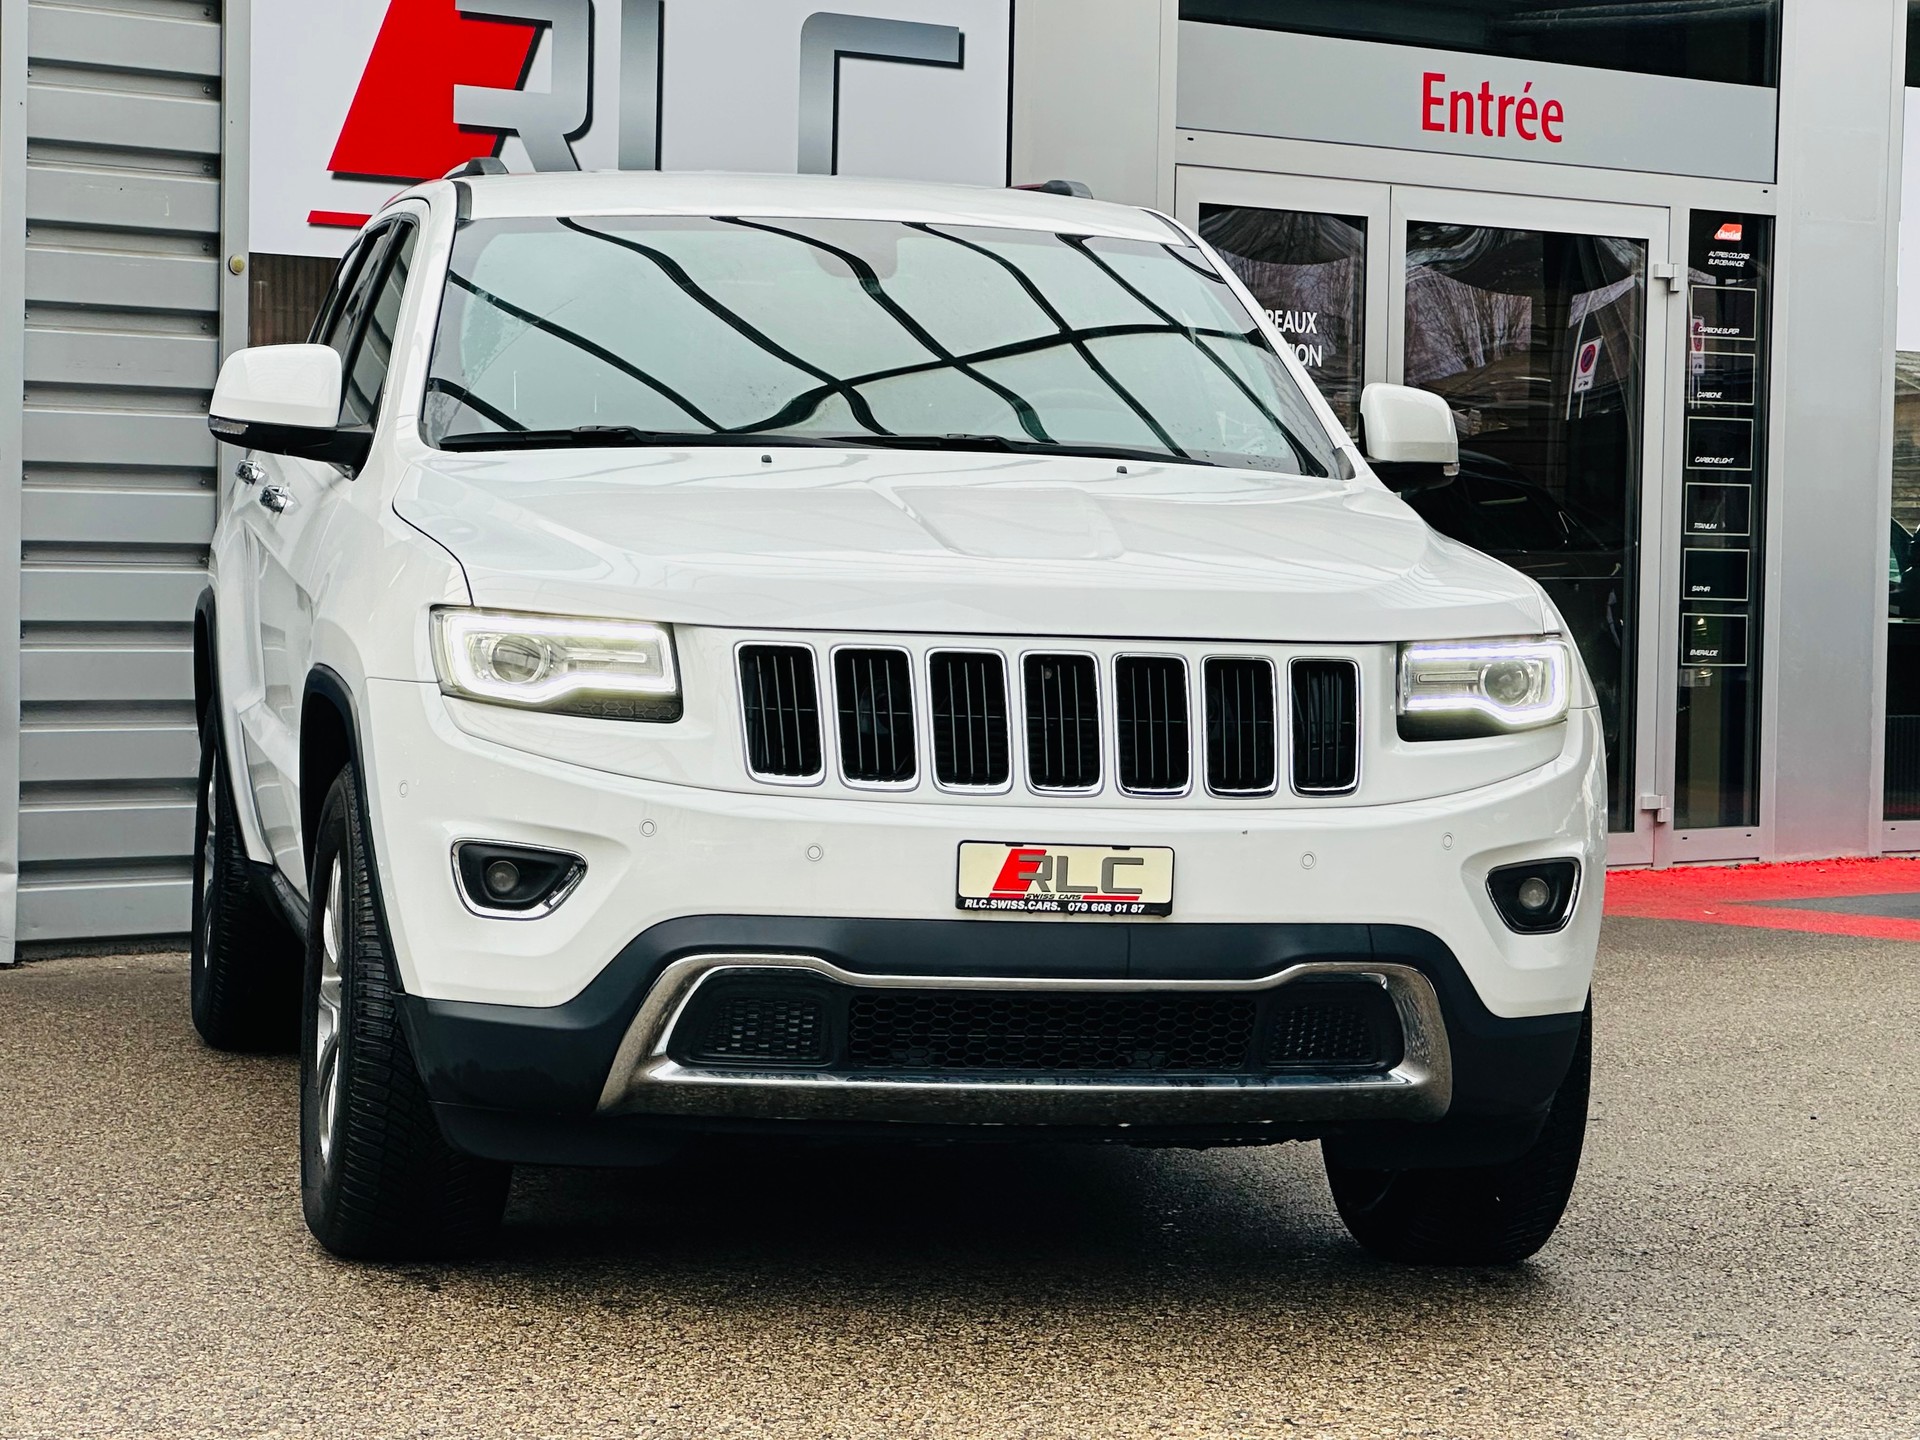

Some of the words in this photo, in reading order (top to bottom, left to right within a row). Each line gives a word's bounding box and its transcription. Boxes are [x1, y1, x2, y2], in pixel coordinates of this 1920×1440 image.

[1422, 72, 1564, 143] Entrée
[1265, 309, 1318, 334] REAUX
[1698, 326, 1722, 334] CARBONE
[1697, 391, 1723, 399] CARBONE
[1694, 456, 1719, 464] CARBONE
[1018, 854, 1144, 895] RLC
[964, 898, 1061, 911] RLC.SWISS.CARS.
[1067, 902, 1089, 912] 079
[1091, 903, 1112, 912] 608
[1114, 904, 1128, 913] 01
[1130, 904, 1145, 914] 87
